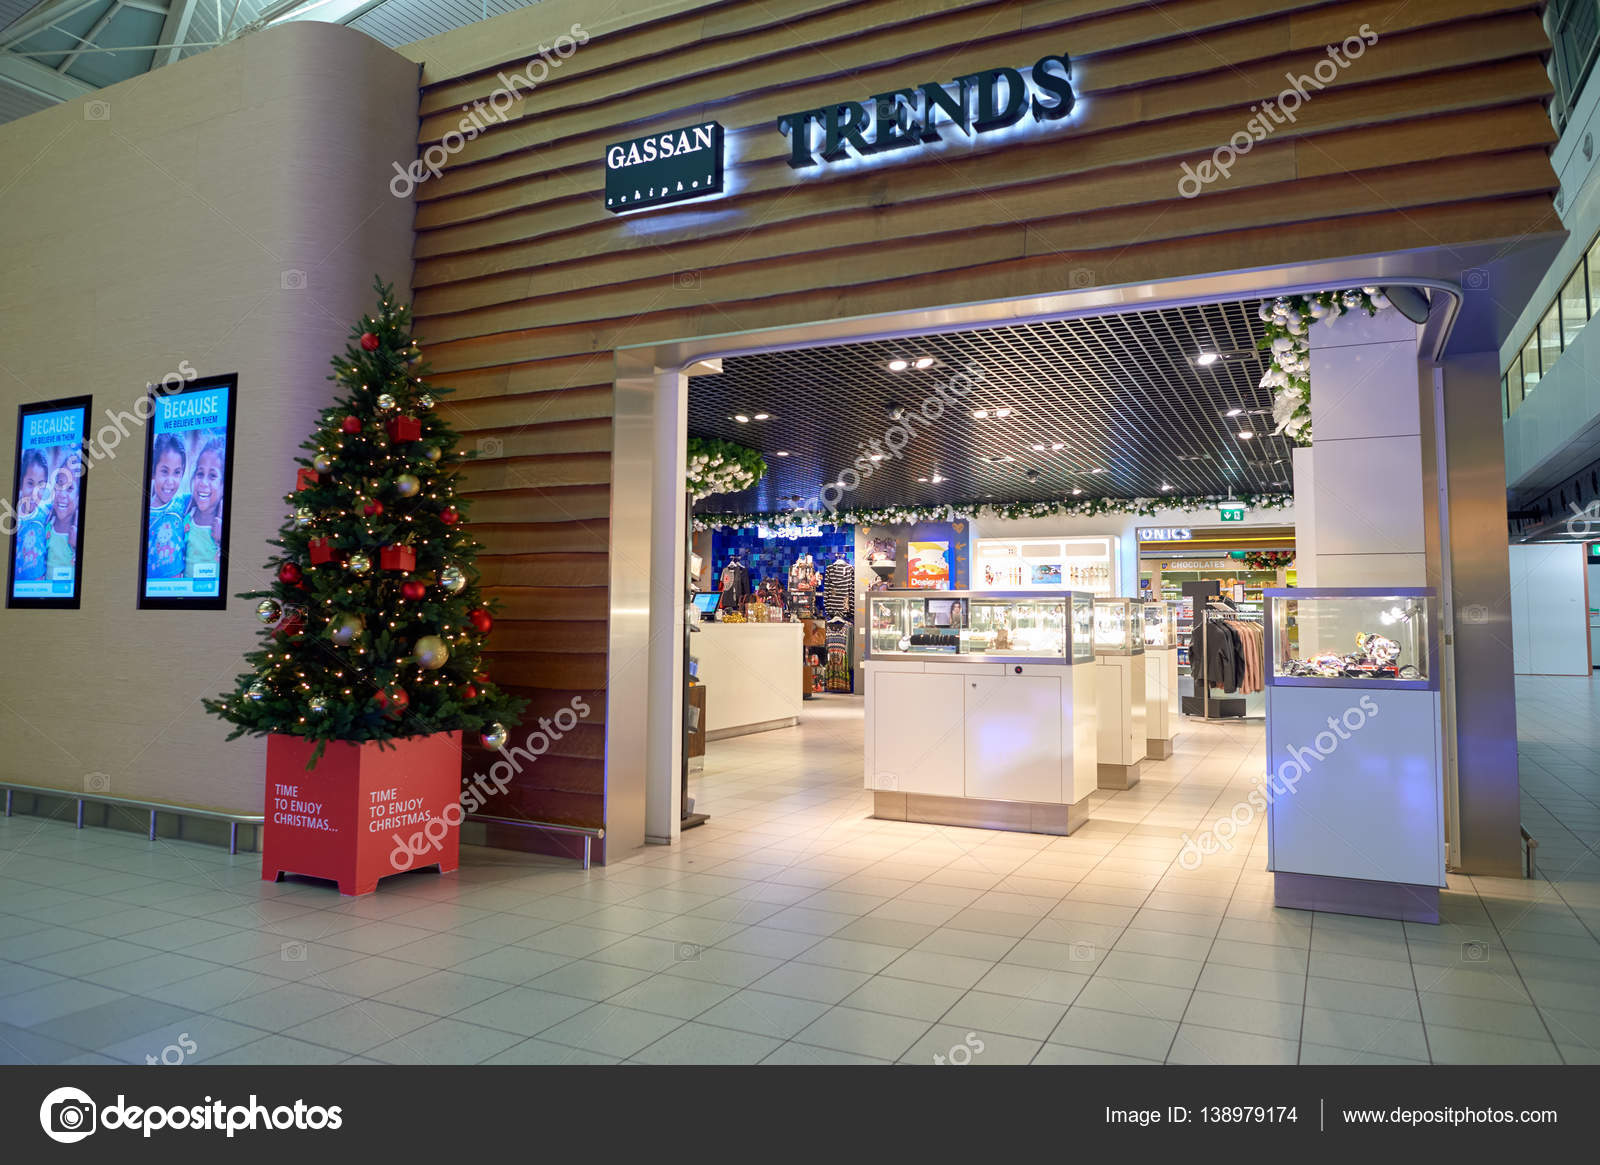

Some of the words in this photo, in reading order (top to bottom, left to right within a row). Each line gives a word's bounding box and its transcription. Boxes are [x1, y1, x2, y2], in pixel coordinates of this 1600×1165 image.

[777, 52, 1076, 169] TRENDS
[607, 125, 714, 169] GASSAN
[607, 175, 712, 205] schiphol
[164, 396, 218, 419] BECAUSE
[30, 415, 76, 436] BECAUSE
[173, 418, 194, 428] BELIEVE
[202, 415, 218, 424] THEM
[1171, 561, 1225, 569] CHOCOLATES
[274, 783, 299, 798] TIME
[369, 787, 398, 804] TIME
[274, 798, 288, 811] TO
[290, 800, 322, 815] ENJOY
[369, 805, 386, 818] TO
[389, 797, 424, 815] ENJOY
[273, 812, 339, 832] CHRISTMAS...
